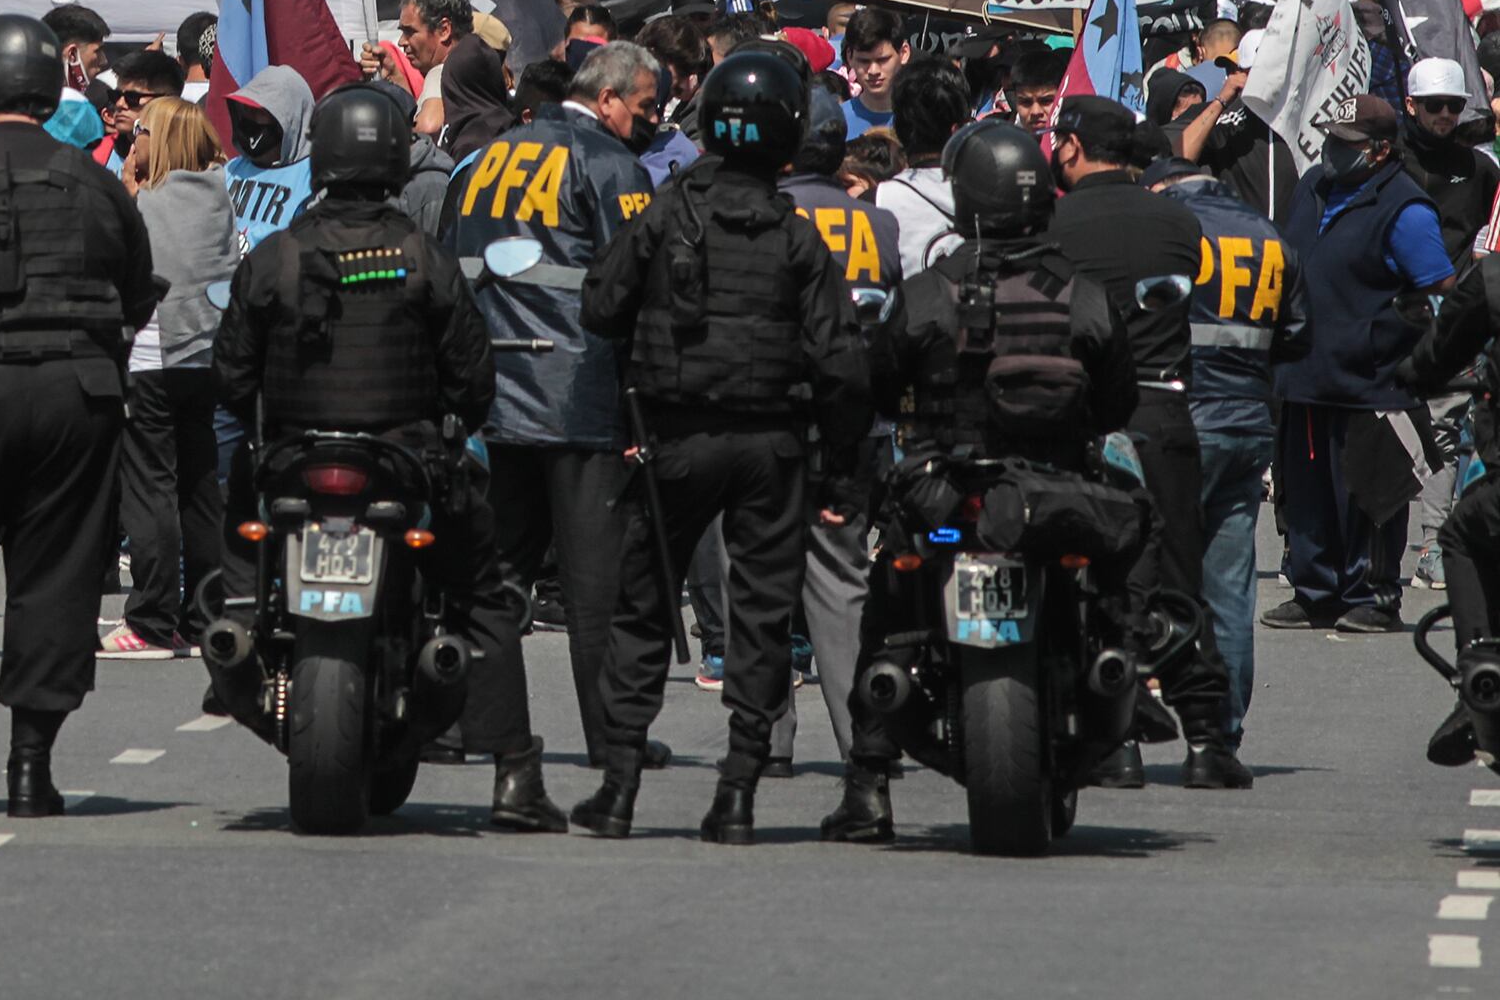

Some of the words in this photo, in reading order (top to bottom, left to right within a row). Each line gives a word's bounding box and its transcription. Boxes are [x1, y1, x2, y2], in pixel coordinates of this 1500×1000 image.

[714, 119, 760, 143] PFA
[462, 141, 569, 227] PFA
[795, 208, 881, 283] FA
[301, 590, 363, 613] PFA
[957, 619, 1021, 642] PFA
